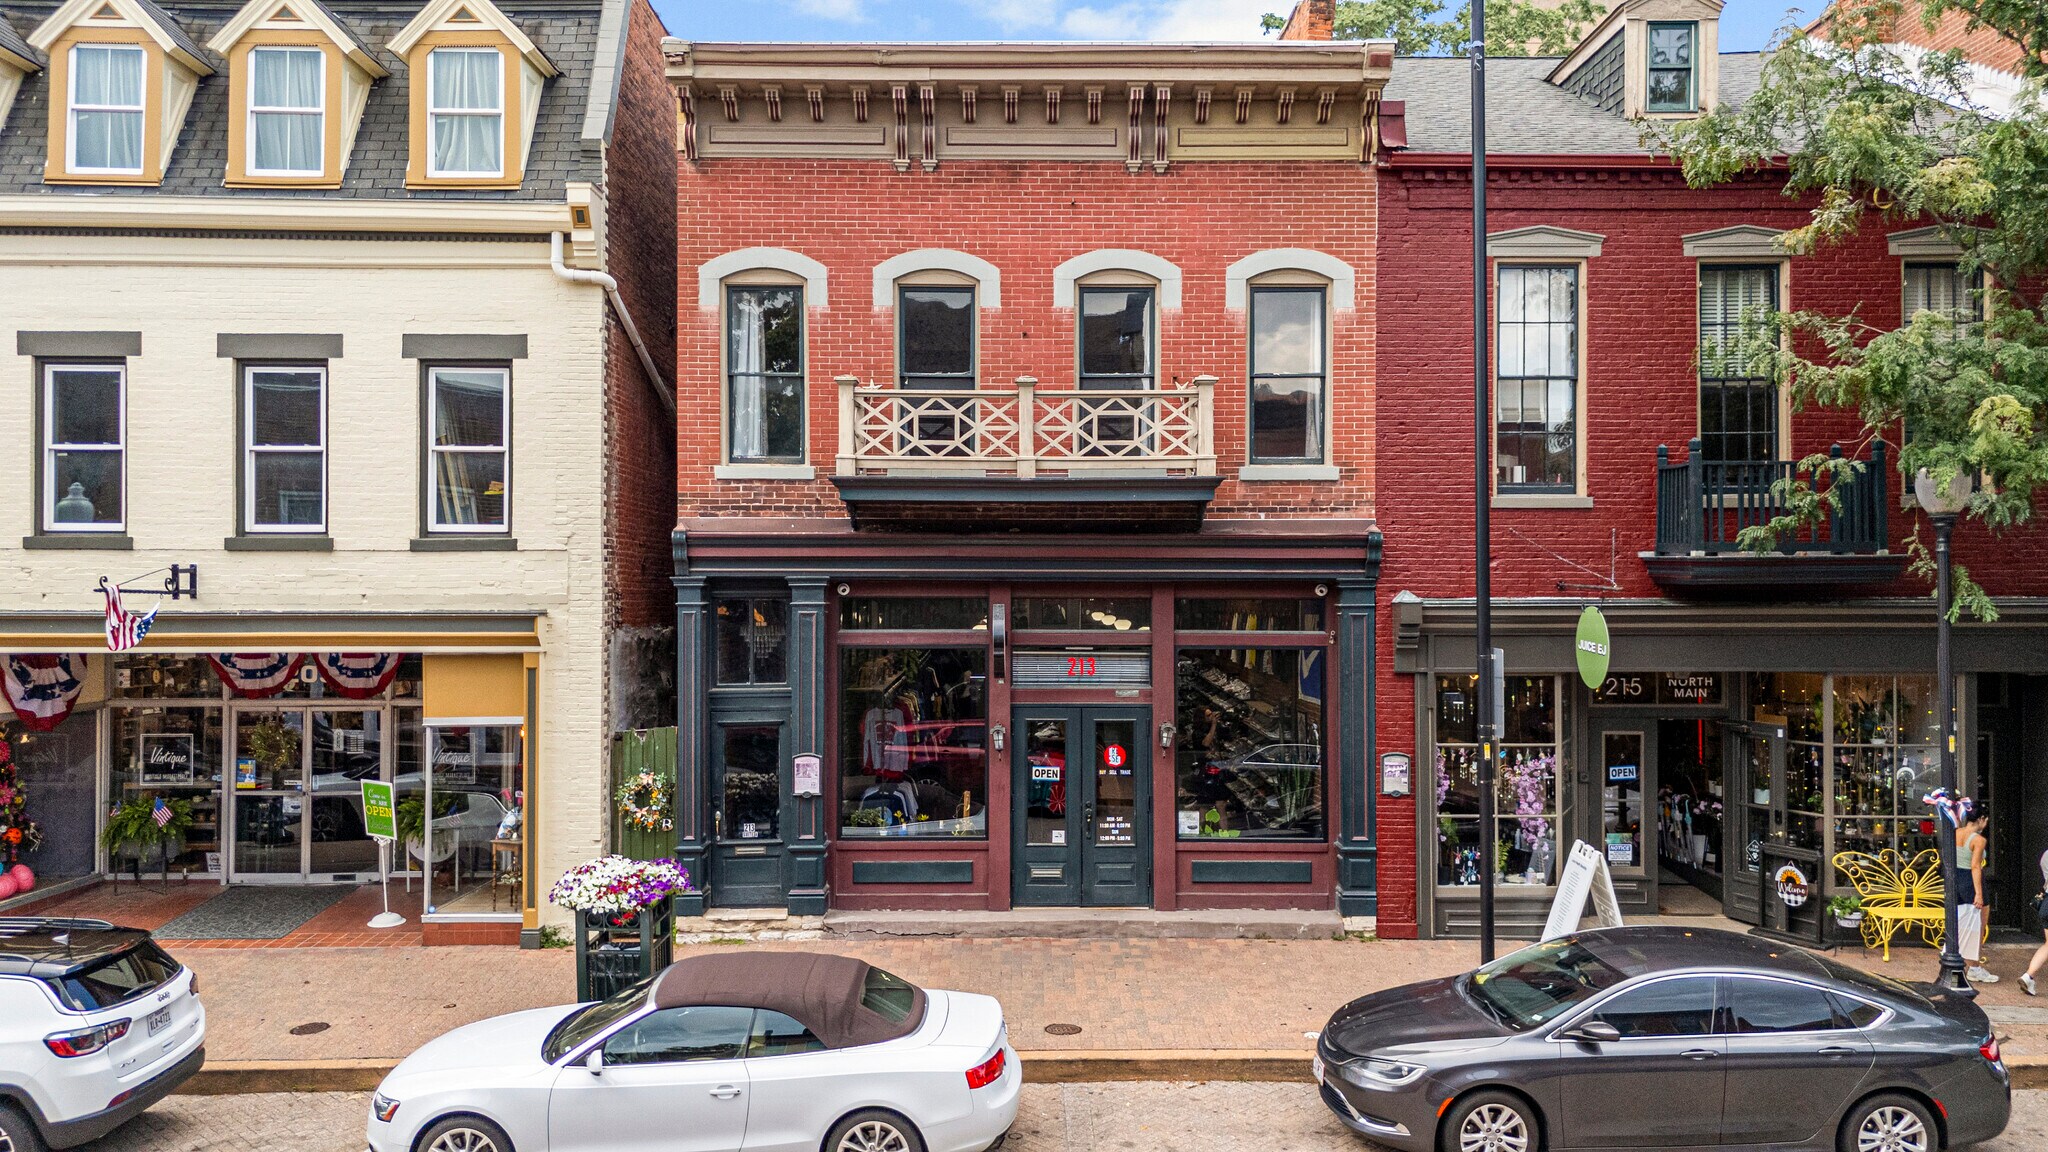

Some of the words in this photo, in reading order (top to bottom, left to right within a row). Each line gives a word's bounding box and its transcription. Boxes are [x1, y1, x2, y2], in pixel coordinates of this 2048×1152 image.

[1577, 639, 1596, 654] JUICE
[1597, 643, 1607, 656] EJ
[1067, 657, 1096, 676] 213
[1605, 678, 1642, 696] 215
[1668, 677, 1713, 687] NORTH
[1674, 688, 1708, 698] MAIN
[150, 746, 187, 770] Vintique
[432, 746, 471, 771] Vintique
[1034, 769, 1058, 778] OPEN
[1611, 768, 1634, 778] OPEN
[366, 804, 392, 818] OPEN
[743, 823, 756, 832] 213
[1777, 880, 1806, 895] Welcome
